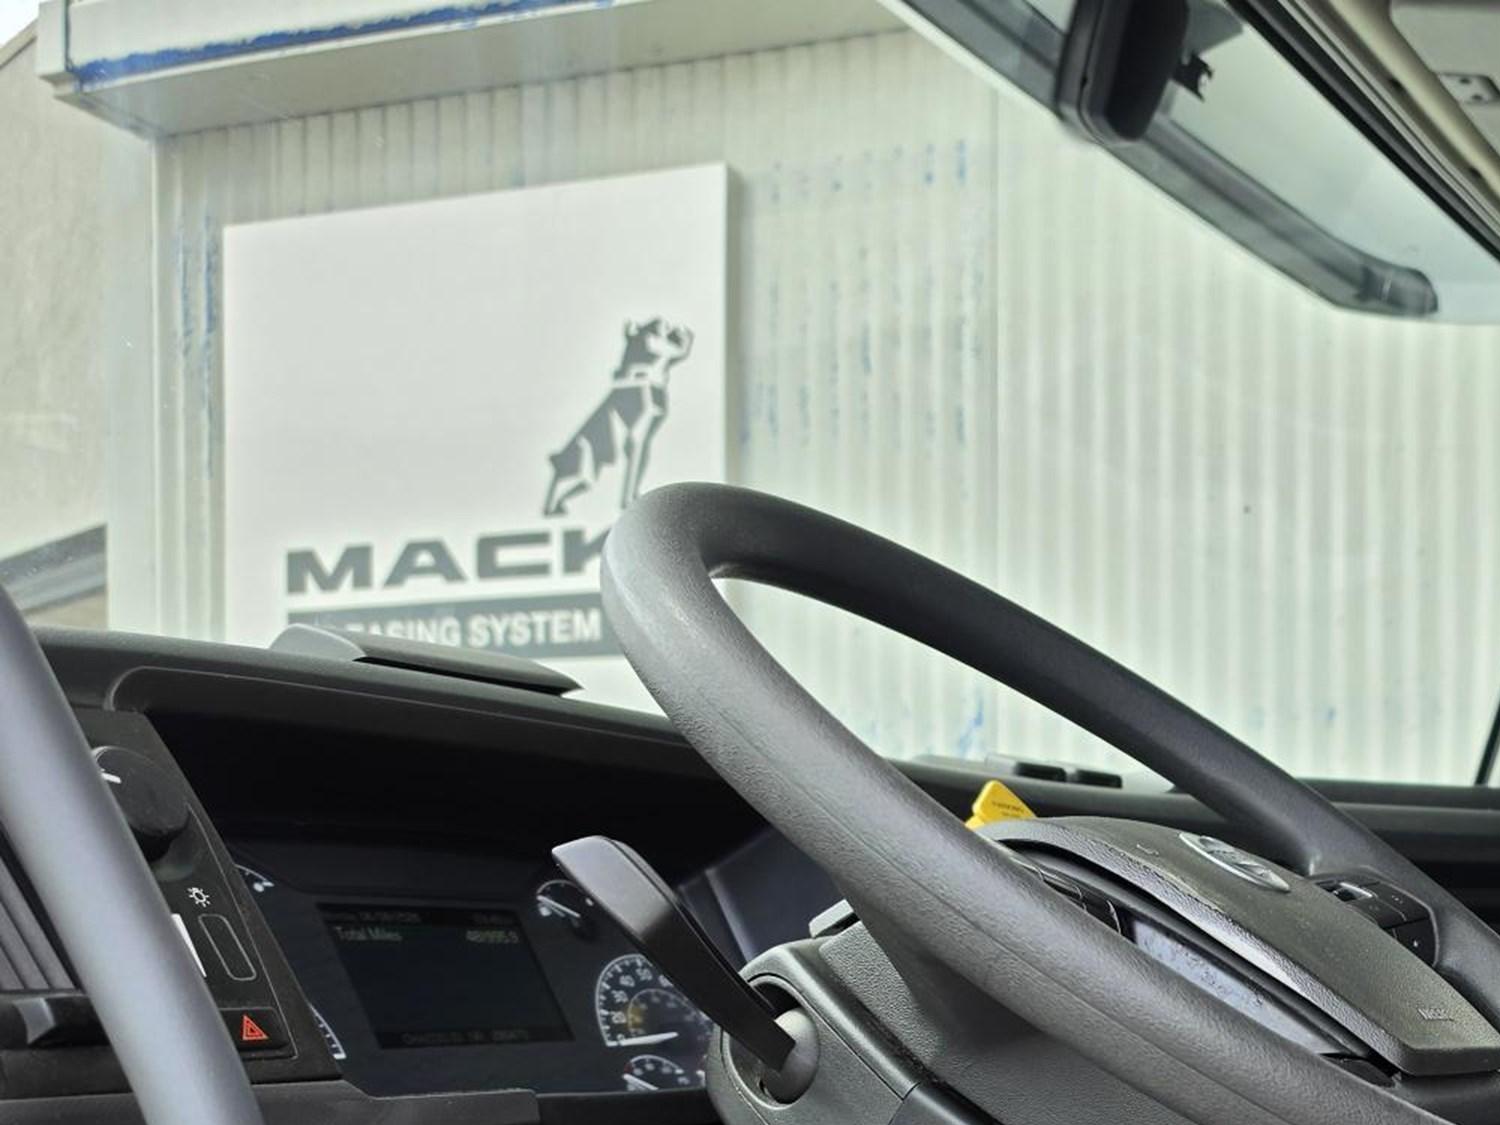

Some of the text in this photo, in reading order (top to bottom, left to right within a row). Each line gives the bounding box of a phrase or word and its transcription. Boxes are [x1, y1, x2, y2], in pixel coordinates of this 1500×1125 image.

[287, 528, 609, 594] MACK
[344, 608, 601, 648] SING SYSTEM
